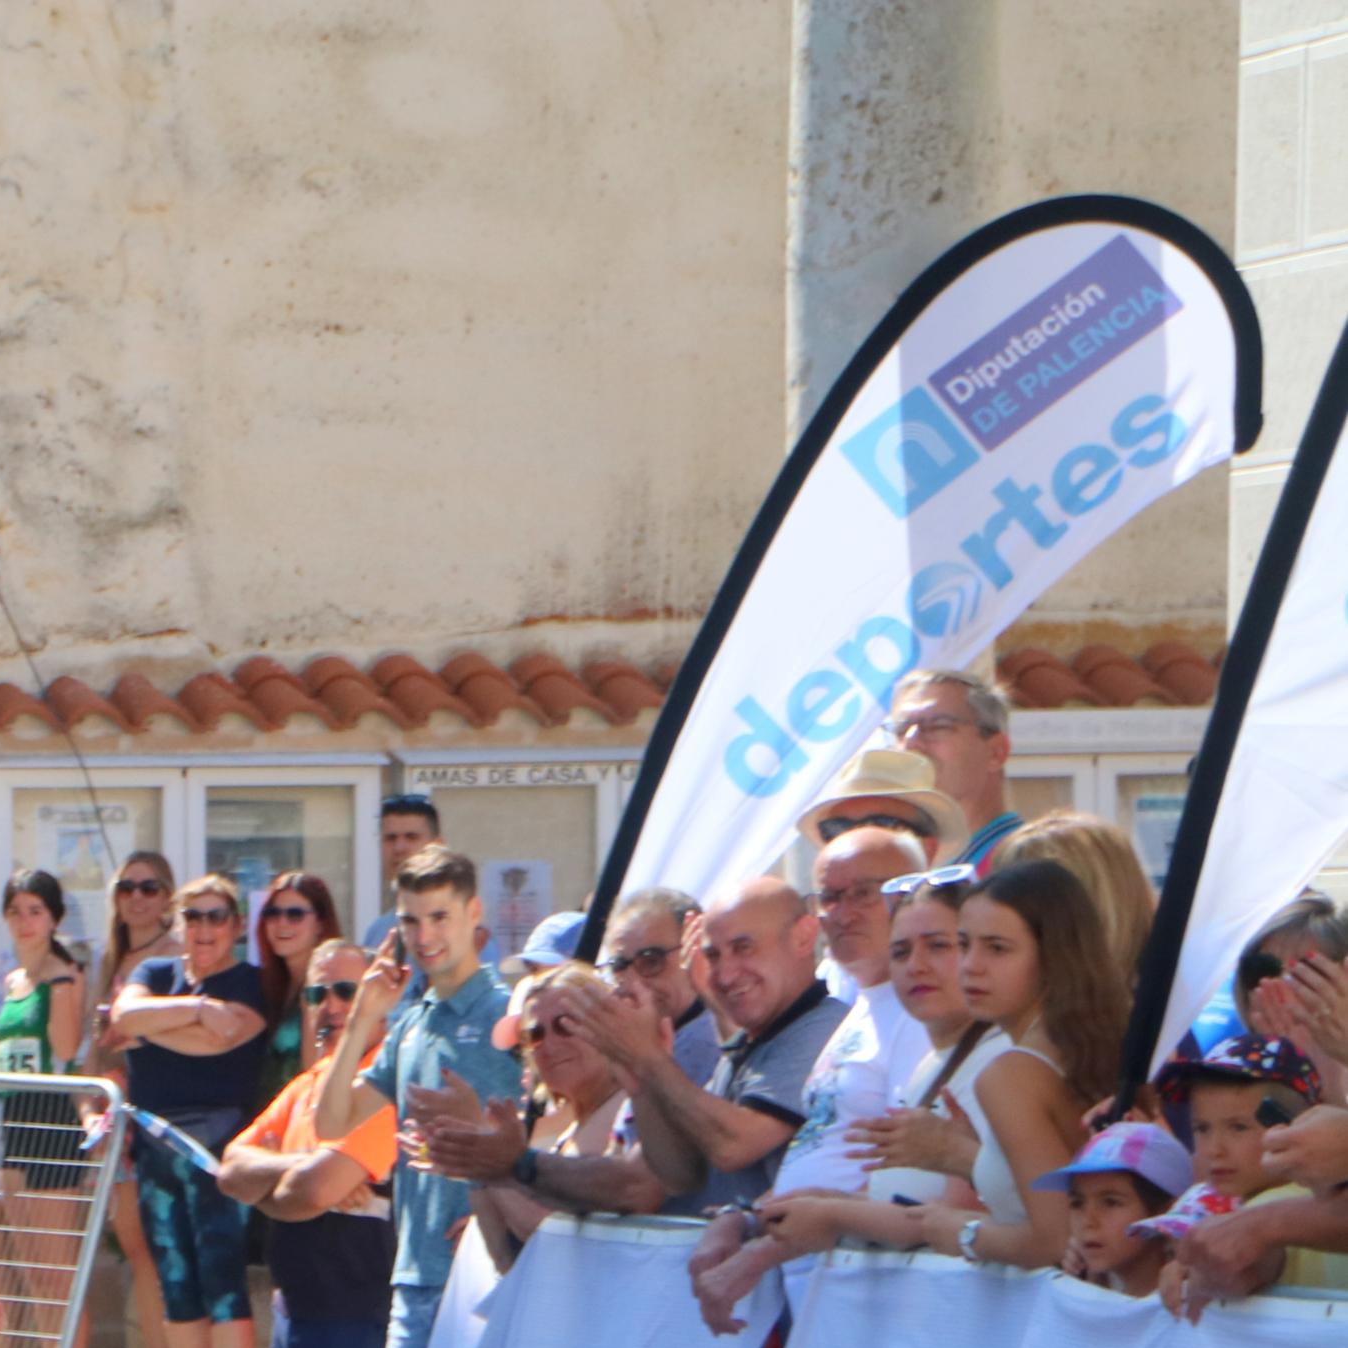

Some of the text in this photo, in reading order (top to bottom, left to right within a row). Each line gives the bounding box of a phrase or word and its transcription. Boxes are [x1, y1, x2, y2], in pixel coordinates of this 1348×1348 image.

[944, 278, 1106, 406] Diputación
[970, 283, 1166, 436] DE PALENCIA
[723, 393, 1190, 800] deportes
[416, 766, 478, 785] AMAS
[488, 768, 517, 785] DE
[527, 766, 588, 784] CASA
[596, 766, 609, 784] Y
